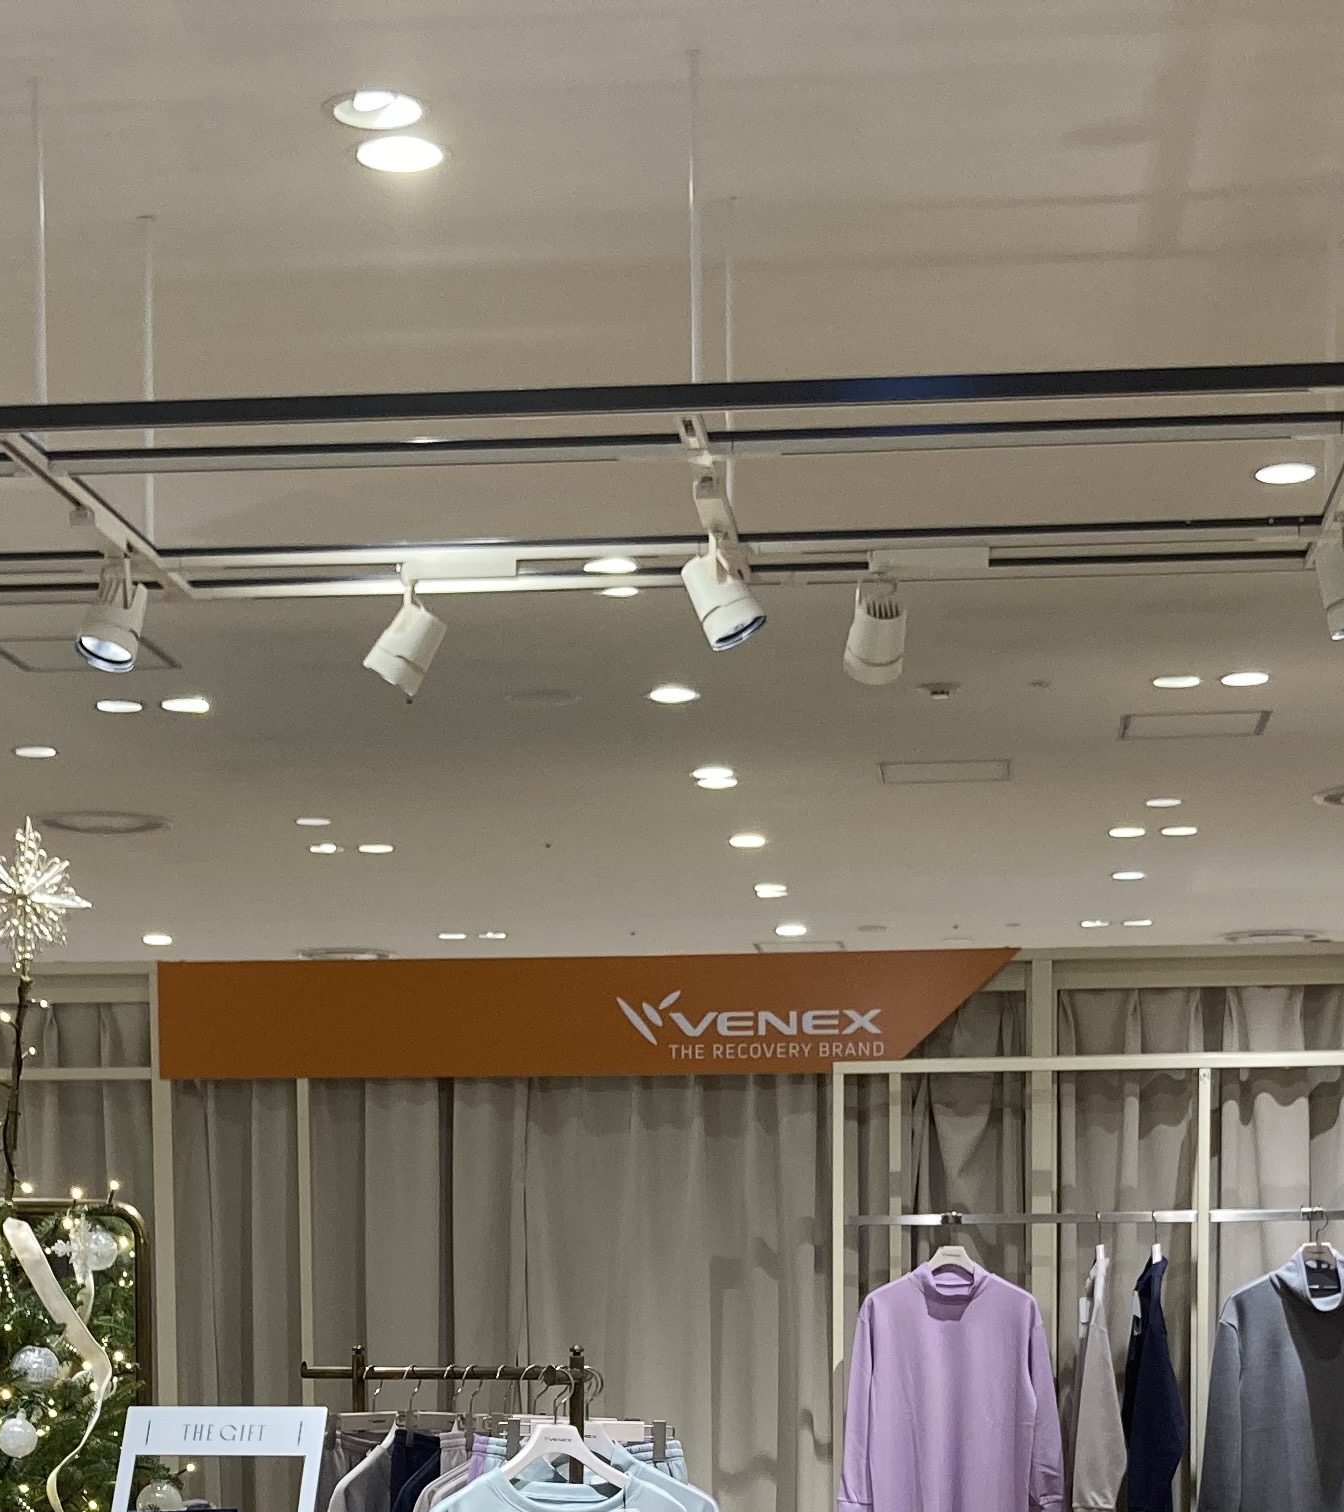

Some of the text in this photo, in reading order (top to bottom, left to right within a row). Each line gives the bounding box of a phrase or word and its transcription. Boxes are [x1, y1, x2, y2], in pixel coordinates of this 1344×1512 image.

[668, 1008, 883, 1037] VENEX
[668, 1041, 886, 1060] THE RECOVERY BRAND
[182, 1424, 268, 1442] THE GIFT
